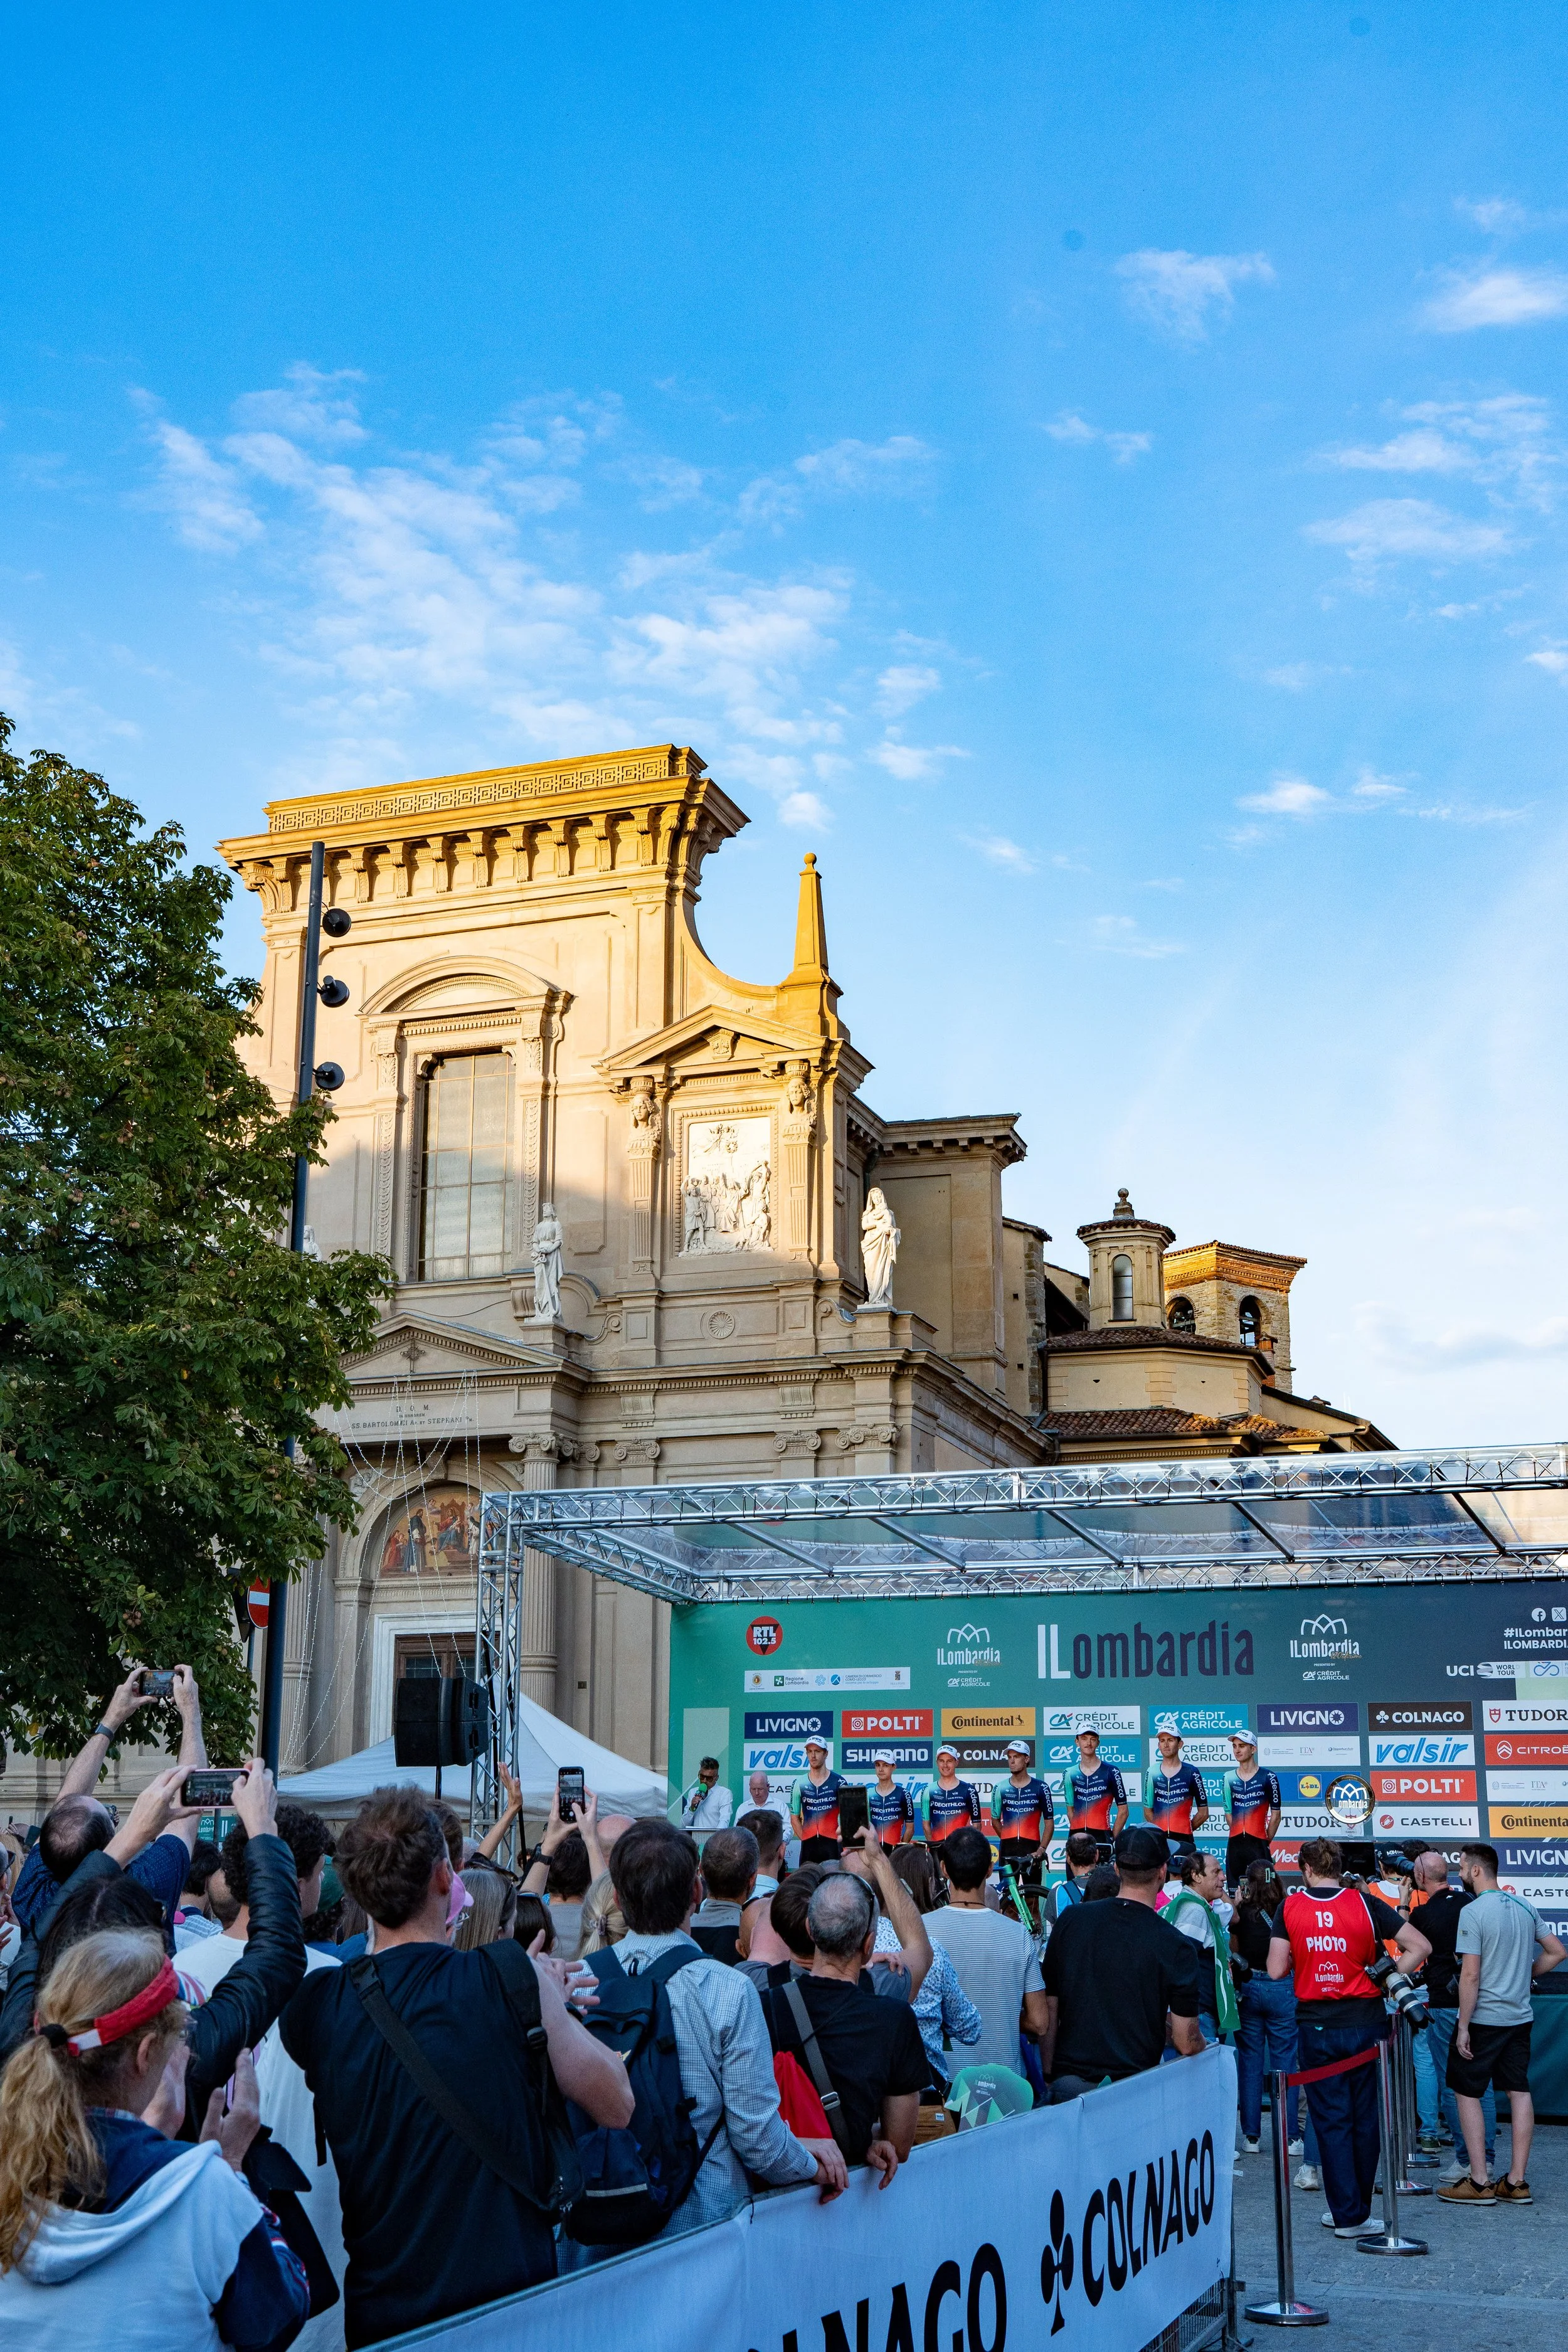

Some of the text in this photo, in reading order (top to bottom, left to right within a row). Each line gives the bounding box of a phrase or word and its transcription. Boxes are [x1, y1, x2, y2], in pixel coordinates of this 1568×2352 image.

[753, 1626, 776, 1637] RTL
[1504, 1640, 1568, 1650] ILOMBARDI
[1446, 1665, 1474, 1677] UCI
[1075, 1712, 1118, 1721] CRÉDIT
[1182, 1710, 1226, 1720] CRÉDIT
[1271, 1710, 1345, 1725] LIVIGNO
[1392, 1712, 1465, 1723] COLNAGO
[1505, 1709, 1568, 1721] TUDOR
[756, 1717, 822, 1732] LIVIGNO
[951, 1715, 1014, 1729] Continental
[1182, 1720, 1242, 1729] AGRICOLE
[1182, 1744, 1226, 1752] CRÉDIT
[846, 1749, 928, 1762] SHIANO
[963, 1750, 1009, 1761] COLNA
[1182, 1754, 1236, 1762] AGRICOL
[1401, 1818, 1471, 1826] CASTELLI
[1315, 1911, 1333, 1928] 19
[1306, 1935, 1347, 1953] PHOTO
[1082, 2129, 1214, 2307] COLNAGO
